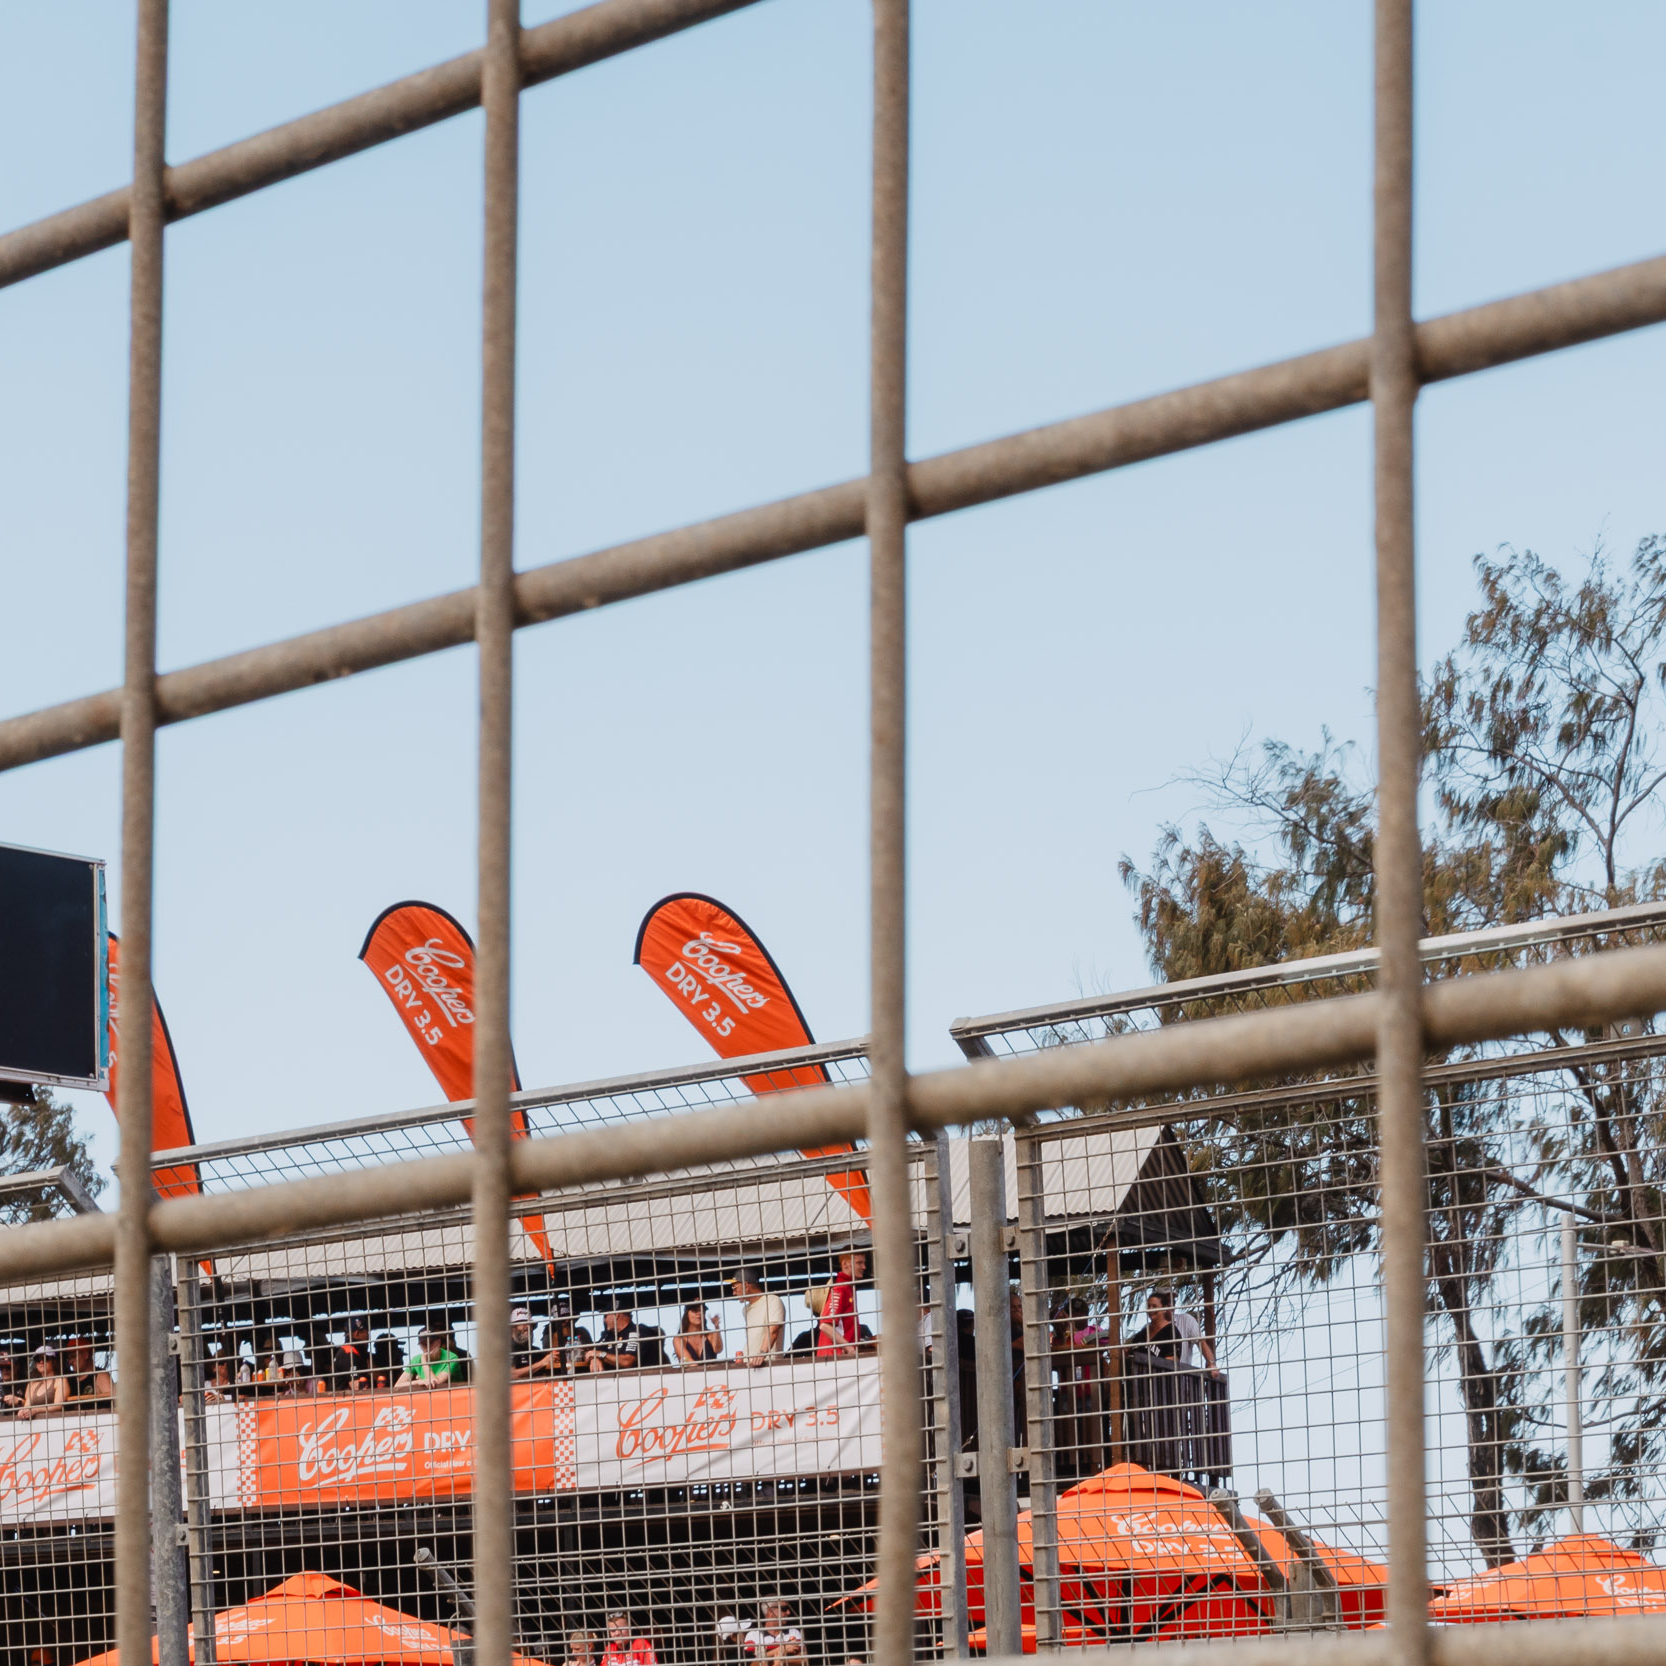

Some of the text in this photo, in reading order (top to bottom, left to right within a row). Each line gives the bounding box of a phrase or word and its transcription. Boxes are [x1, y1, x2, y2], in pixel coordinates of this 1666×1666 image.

[384, 964, 443, 1045] DRY 3.5
[405, 938, 476, 1026] Coopers
[665, 961, 736, 1037] DRY 3.5
[682, 931, 770, 1013] Coopers
[299, 1408, 471, 1486] Coopers DRY
[616, 1387, 738, 1466] Coopers
[750, 1407, 798, 1431] DRY
[805, 1405, 840, 1427] 3.5
